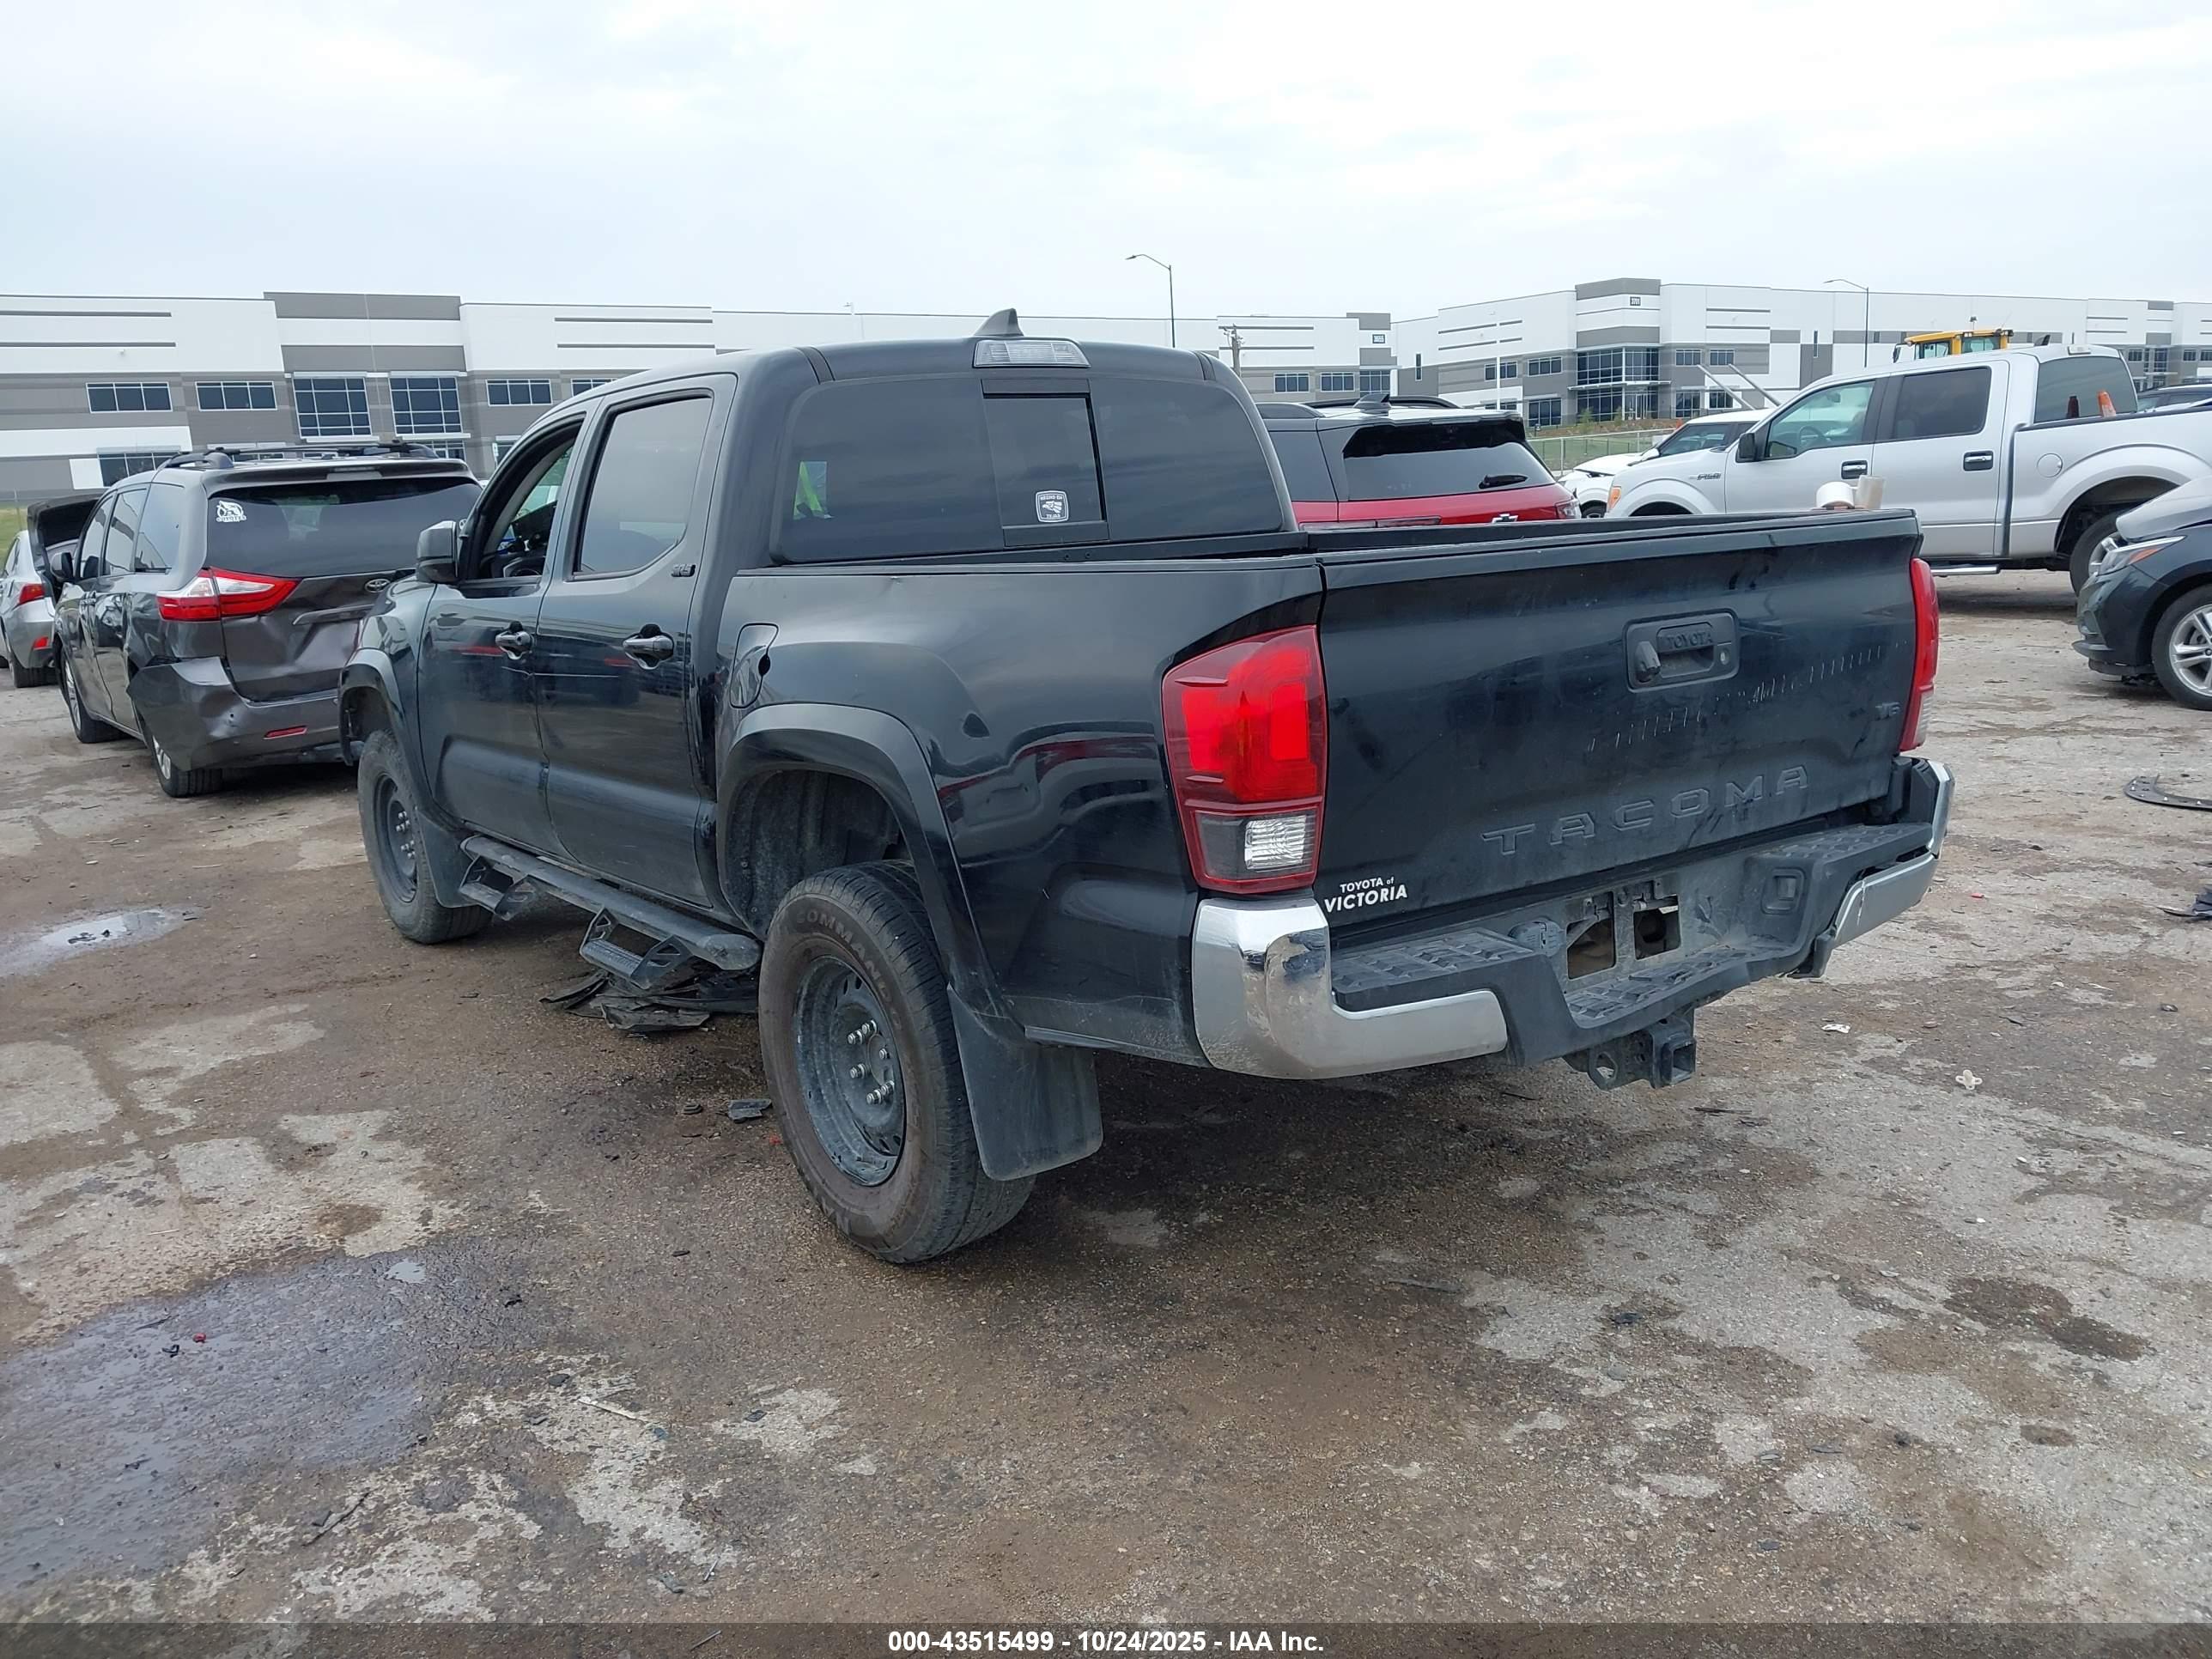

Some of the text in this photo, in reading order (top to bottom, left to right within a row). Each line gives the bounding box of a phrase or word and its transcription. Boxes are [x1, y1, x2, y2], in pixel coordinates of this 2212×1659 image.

[1666, 631, 1714, 649] TOYOTA
[1480, 765, 1808, 856] TACOMA
[1340, 876, 1395, 893] TOYOTA of
[1324, 884, 1407, 913] VICTORIA
